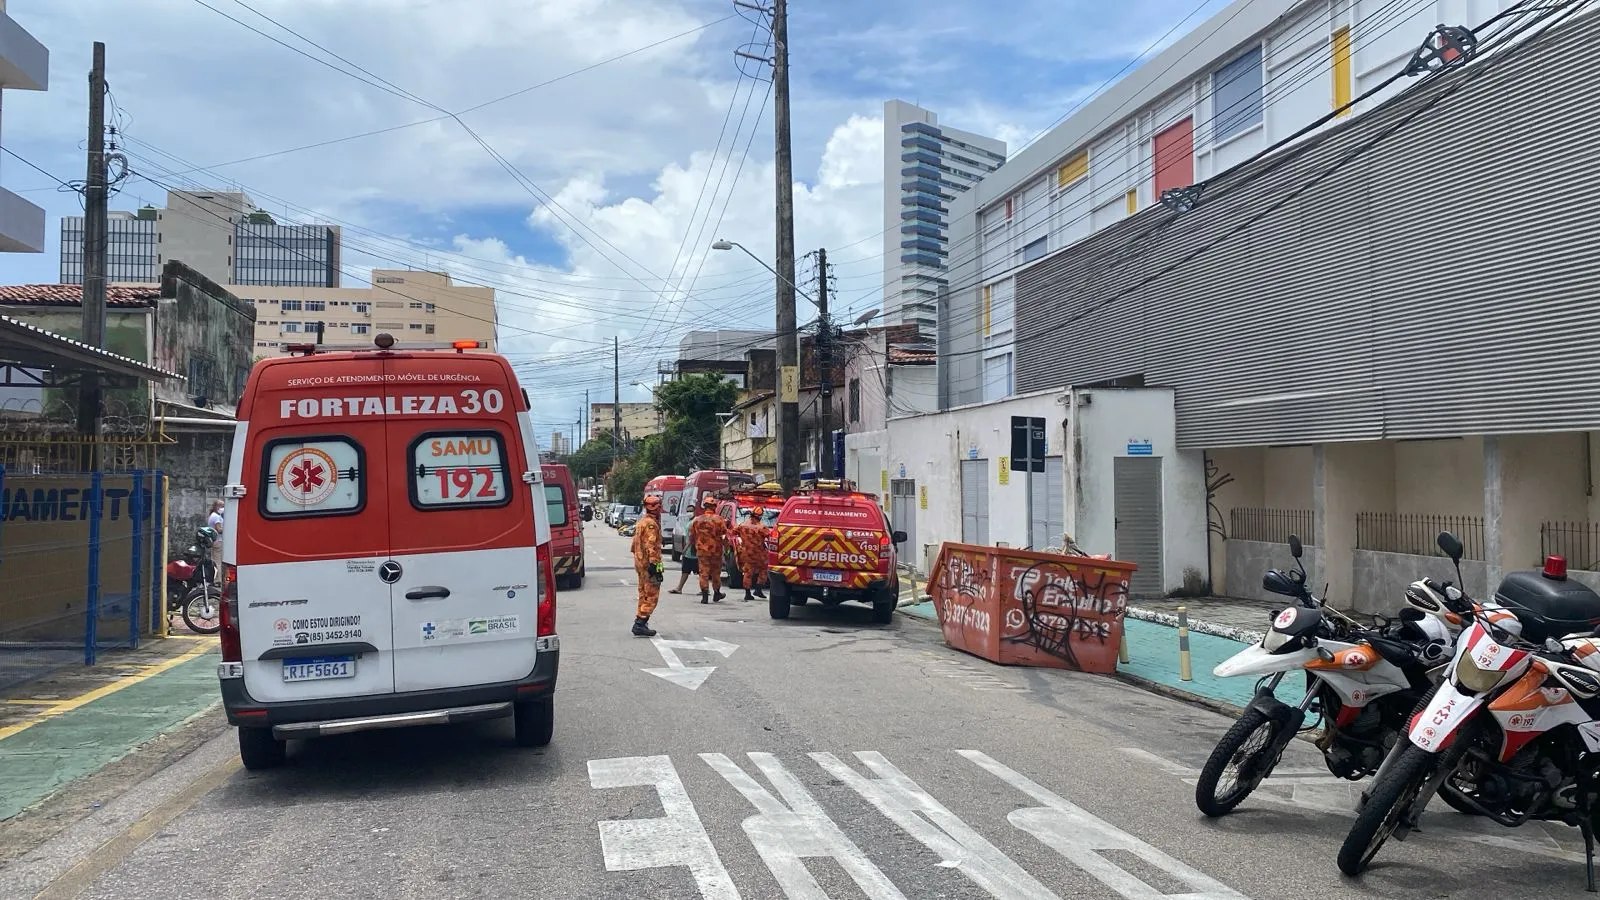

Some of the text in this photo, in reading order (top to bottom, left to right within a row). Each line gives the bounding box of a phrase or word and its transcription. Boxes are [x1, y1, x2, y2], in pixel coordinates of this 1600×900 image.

[287, 377, 322, 386] SERVIÇO
[323, 376, 334, 384] DE
[336, 374, 396, 383] ATENDIMENTO
[397, 373, 426, 381] MÓVEL
[440, 373, 481, 382] URGÊNCIA
[280, 389, 504, 419] FORTALEZA 30
[431, 439, 492, 457] SAMU
[435, 467, 497, 499] 192
[863, 544, 878, 552] 193
[790, 550, 867, 564] BOMBEIROS
[248, 599, 308, 608] SPRINTER
[292, 615, 361, 630] COMO ESTOU DIRIGINDO?
[488, 622, 517, 630] BRASIL
[310, 629, 362, 643] (85) 3452-9140
[1478, 655, 1492, 668] 192
[289, 663, 348, 680] RIF5G61
[1433, 700, 1456, 725] SAMU
[1522, 718, 1535, 727] 192
[1418, 736, 1431, 747] 192
